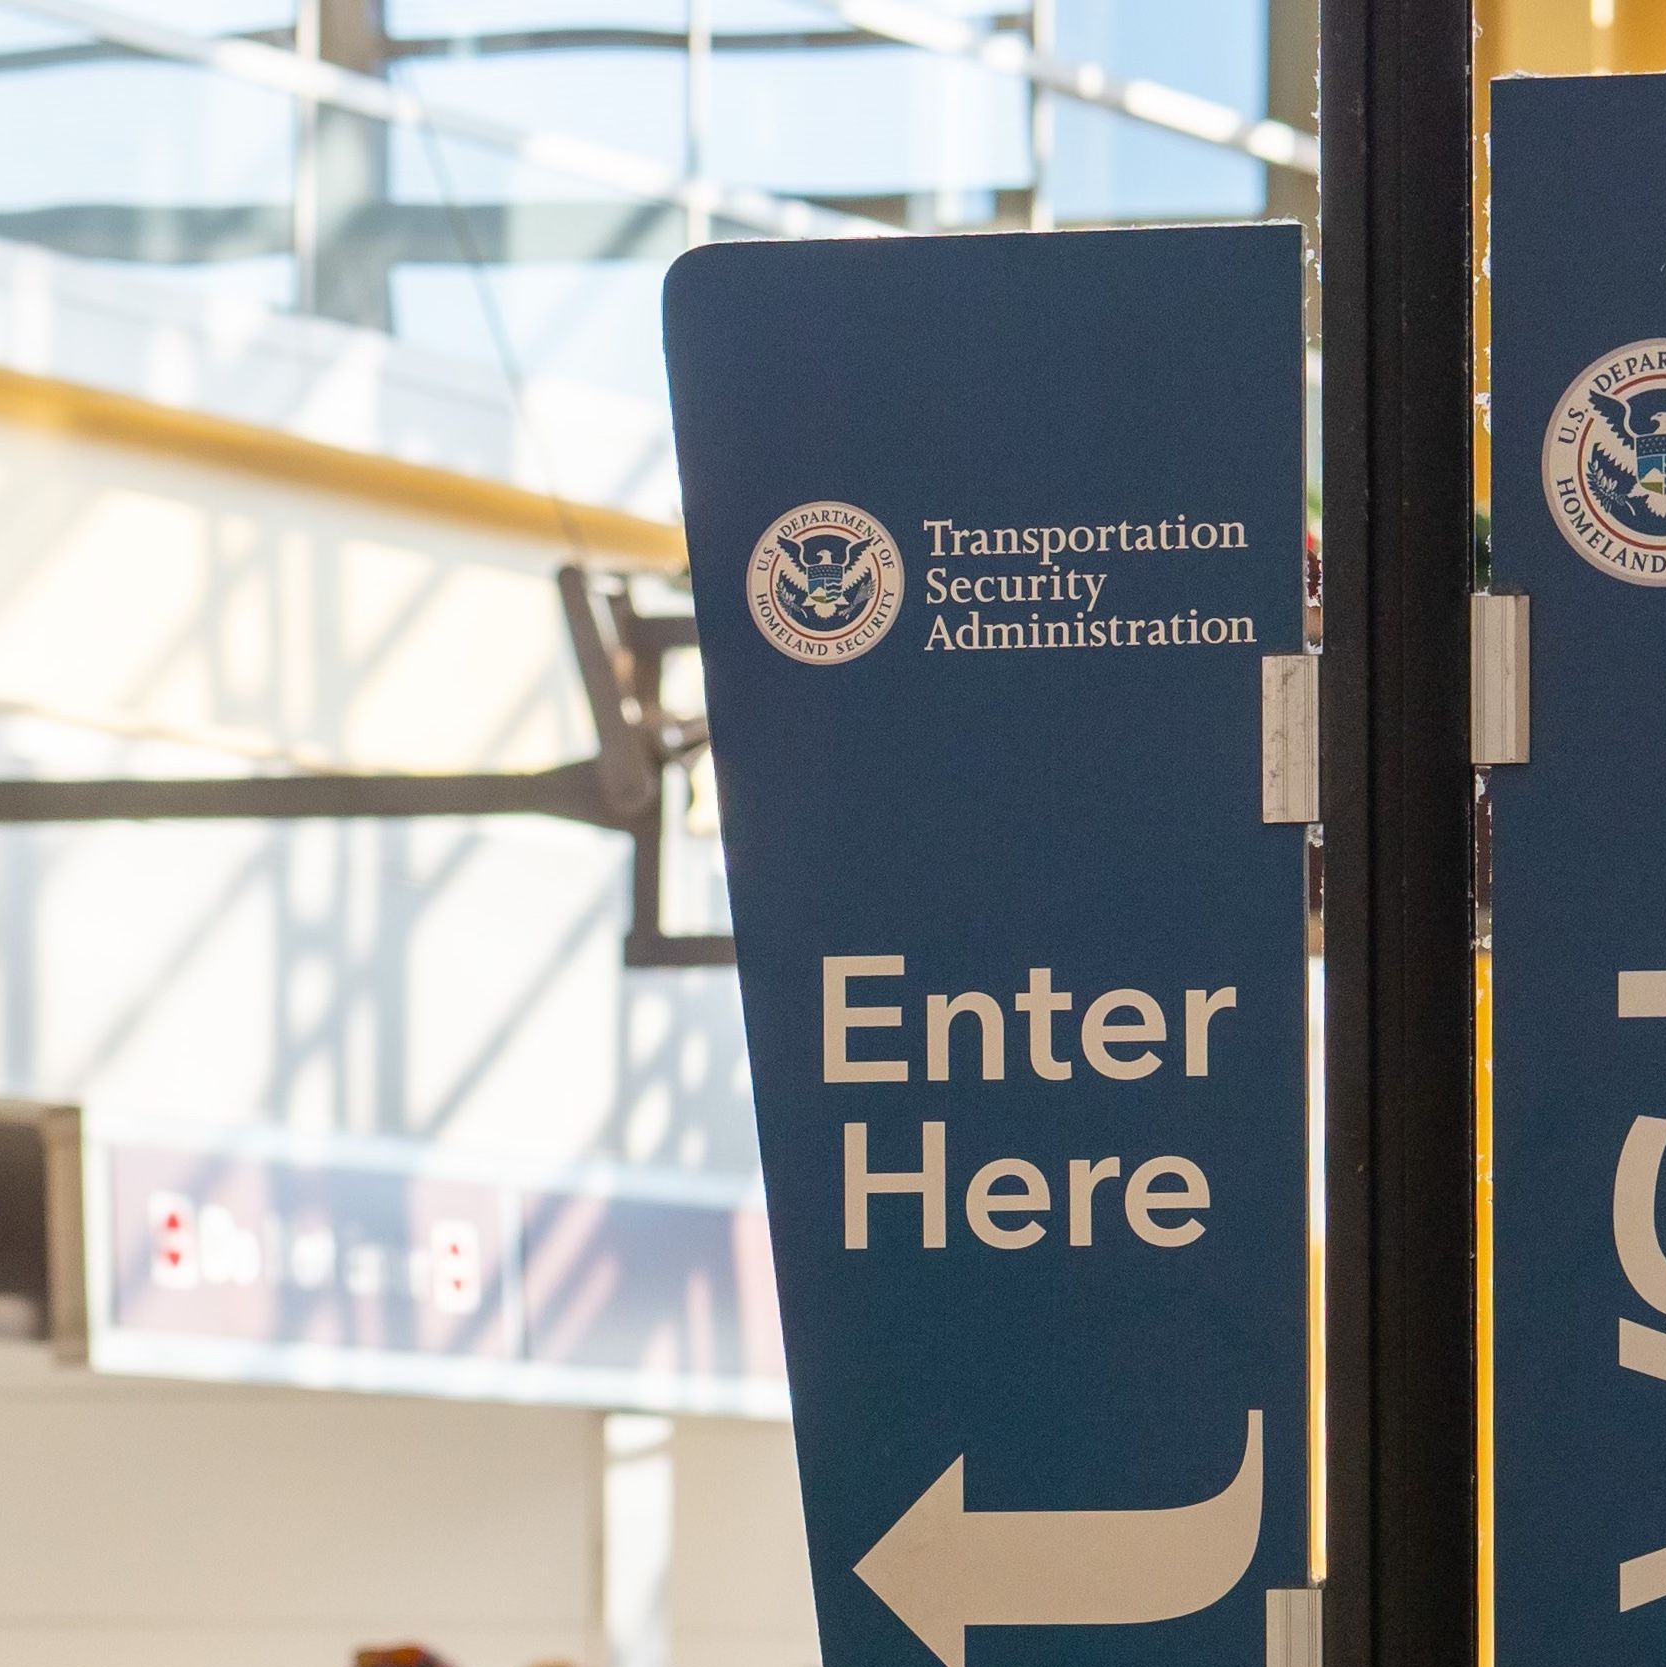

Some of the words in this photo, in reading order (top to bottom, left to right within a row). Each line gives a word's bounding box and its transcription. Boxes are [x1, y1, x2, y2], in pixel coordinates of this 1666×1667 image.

[1558, 407, 1588, 443] U.S.
[756, 546, 778, 572] U.S.
[780, 510, 885, 546] DEPARTMENT
[879, 548, 895, 569] OF
[924, 514, 1248, 565] Transportation
[926, 566, 1107, 612] Security
[756, 593, 828, 656] HOMELAND
[836, 589, 895, 655] SECURITY
[924, 607, 1257, 650] Administration
[823, 955, 1236, 1083] Enter
[844, 1122, 1210, 1249] Here
